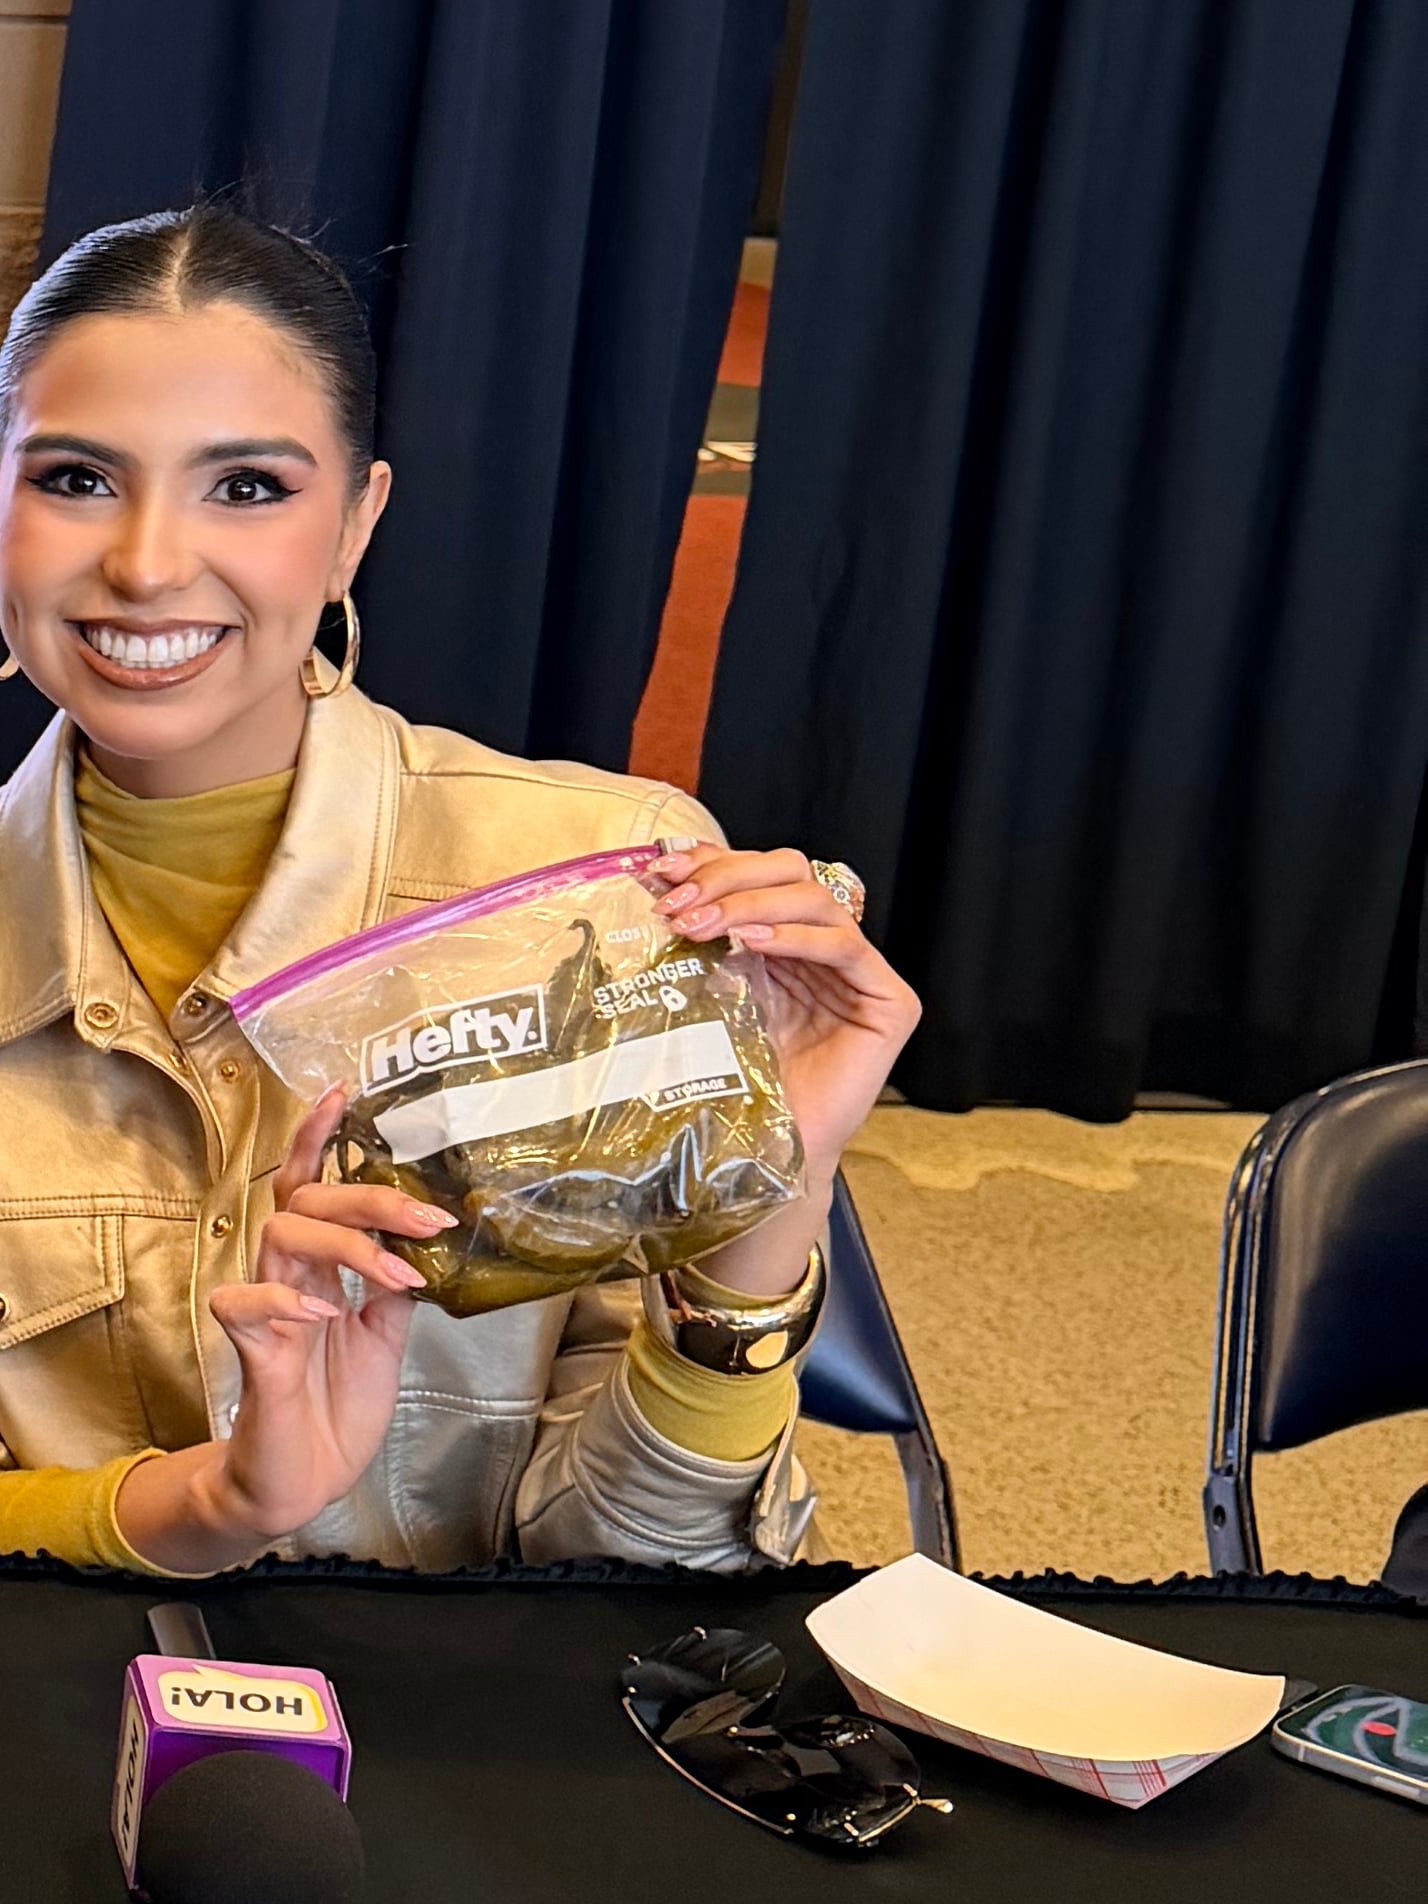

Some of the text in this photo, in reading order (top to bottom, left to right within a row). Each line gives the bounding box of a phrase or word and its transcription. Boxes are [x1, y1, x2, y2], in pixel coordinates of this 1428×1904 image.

[594, 958, 706, 1005] STRONGER
[598, 989, 659, 1020] SEAL
[170, 1686, 304, 1716] HOLA!
